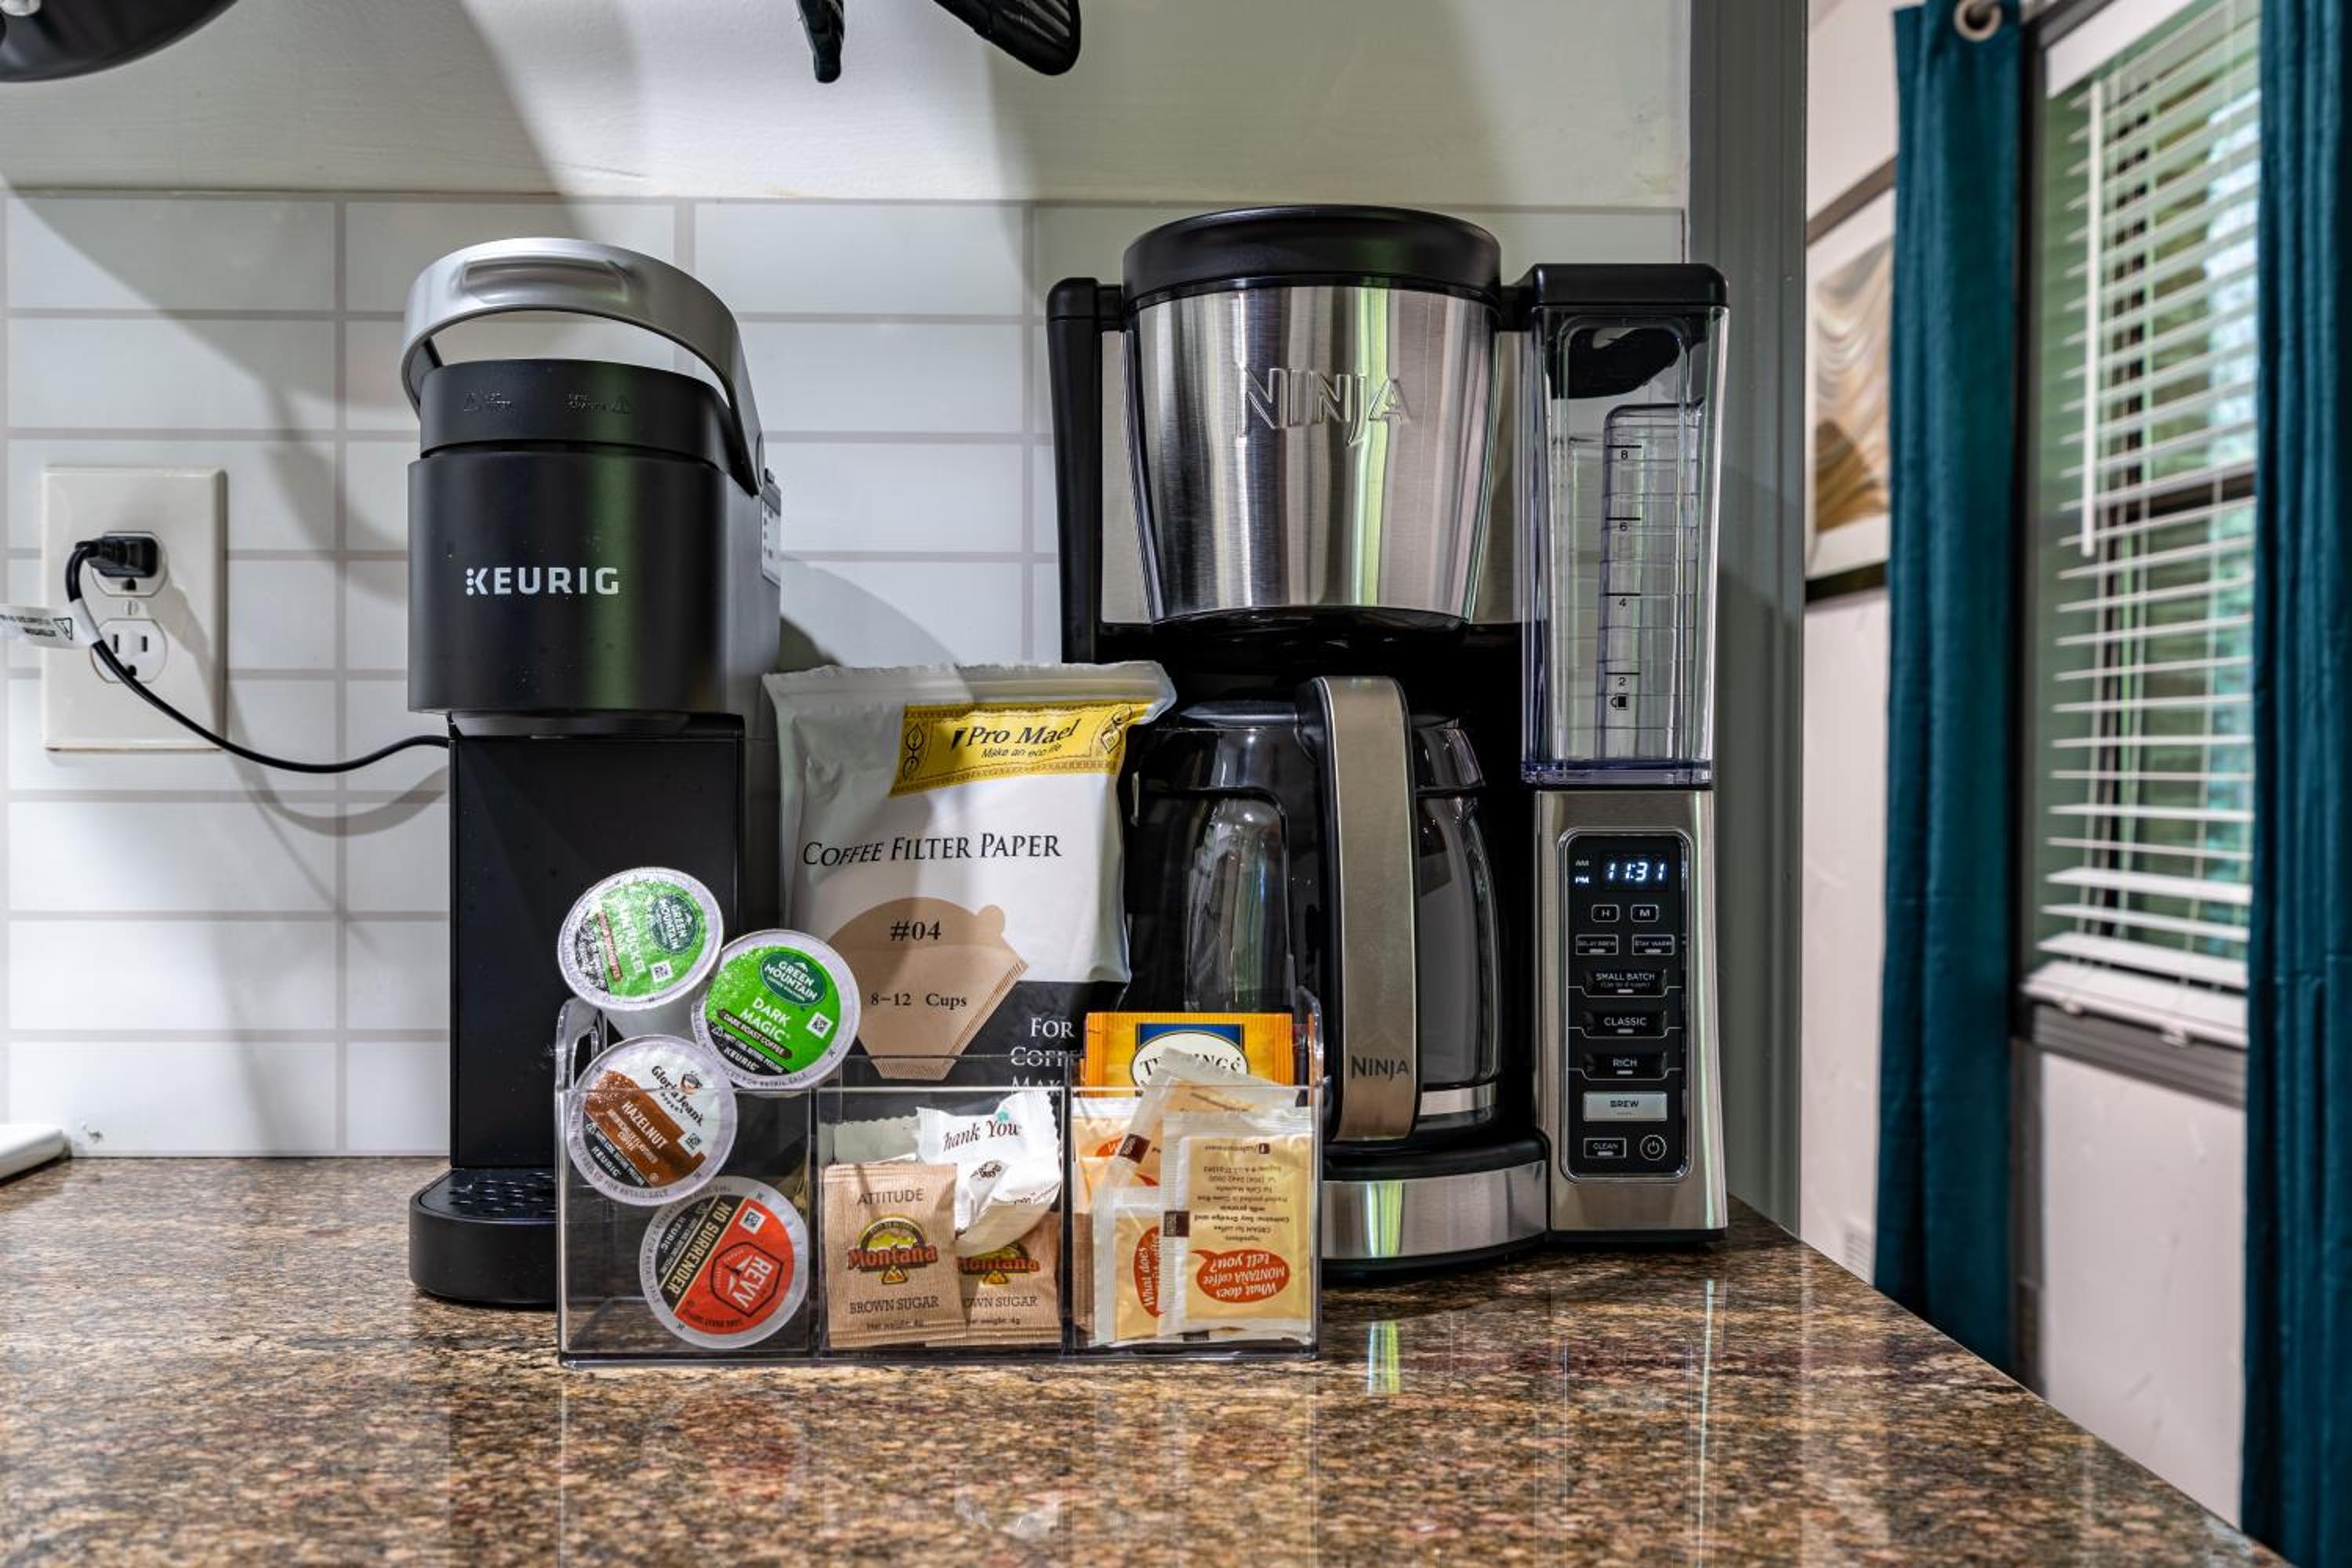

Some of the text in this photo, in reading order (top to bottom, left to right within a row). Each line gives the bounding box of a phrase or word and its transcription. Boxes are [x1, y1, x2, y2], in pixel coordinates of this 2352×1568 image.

[1236, 364, 1411, 450] NINJA
[1620, 449, 1628, 459] 8
[1619, 522, 1627, 532] 6
[466, 567, 619, 596] KEURIG
[1618, 598, 1627, 607] 4
[1618, 677, 1627, 686] 2
[966, 717, 1081, 747] Pro Mael
[982, 748, 1009, 758] Make
[802, 832, 1063, 868] COFFEE FILTER PAPER
[1607, 862, 1665, 882] 11:31
[658, 898, 678, 949] MOUNTAIN
[670, 903, 686, 938] GREEN
[1601, 909, 1610, 917] H
[1639, 909, 1650, 917] M
[890, 920, 942, 942] #04
[762, 963, 818, 1000] MOUNTAIN
[776, 959, 815, 987] GREEN
[1595, 972, 1655, 981] SMALL BATCH
[869, 992, 967, 1010] 8-12 Cups
[750, 996, 792, 1028] DARK
[1603, 1017, 1646, 1026] CLASSIC
[739, 1022, 762, 1041] ROAST
[759, 1036, 786, 1055] COFFEE
[1030, 1017, 1075, 1039] FOR
[1351, 1054, 1410, 1081] NINJA
[1613, 1058, 1637, 1067] RICH
[620, 1098, 668, 1150] HAZELNUT
[987, 1120, 1018, 1138] You
[590, 1144, 621, 1178] KEURIG
[858, 1188, 924, 1205] ATTITUDE
[710, 1200, 732, 1223] NO
[666, 1220, 720, 1295] SURRENDER
[1210, 1253, 1269, 1271] tell you?
[731, 1255, 772, 1308] REVV
[1138, 1247, 1155, 1306] What does
[1203, 1272, 1232, 1284] coffee
[1216, 1282, 1276, 1298] What does
[850, 1295, 940, 1314] BROWN SUGAR
[995, 1296, 1038, 1307] SUGAR
